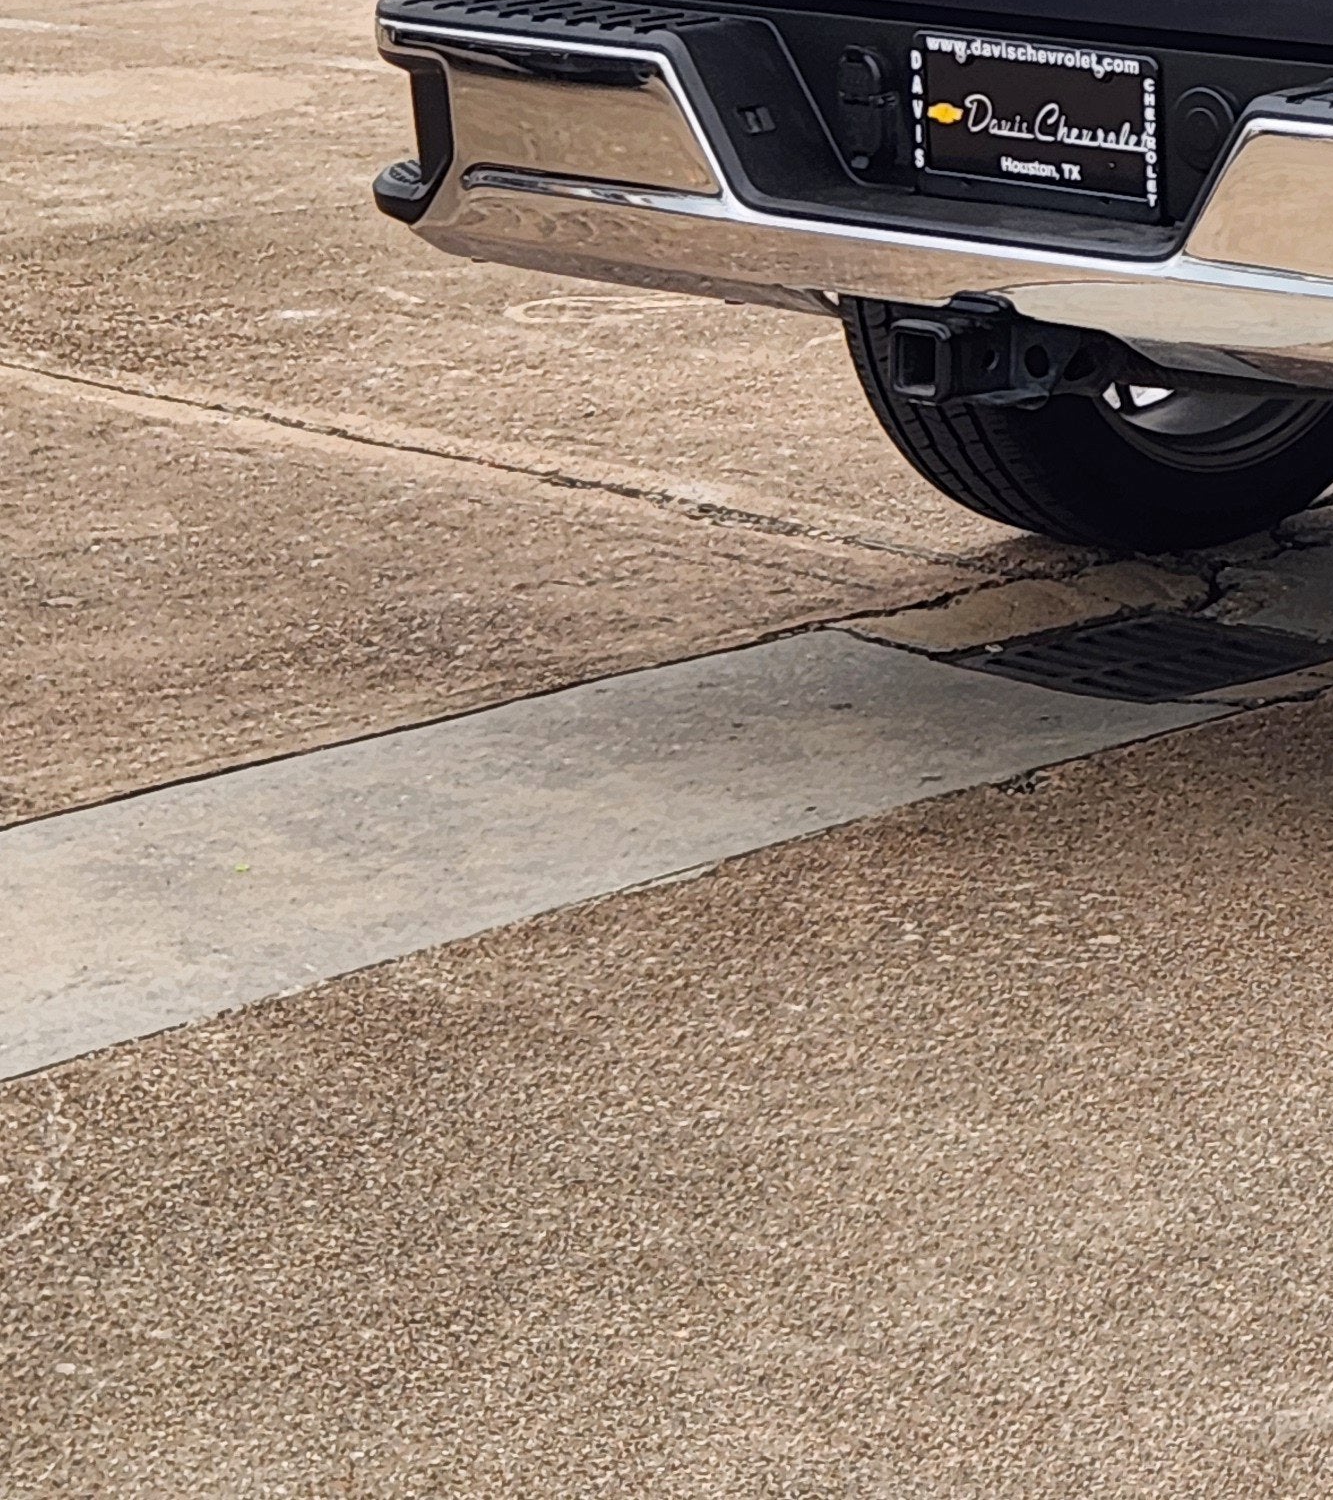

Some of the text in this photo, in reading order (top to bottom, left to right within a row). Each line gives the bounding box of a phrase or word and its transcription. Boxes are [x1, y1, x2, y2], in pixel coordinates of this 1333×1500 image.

[926, 36, 1140, 77] www.davischevrolet.com
[910, 50, 925, 169] DAVIS
[964, 94, 1149, 152] Davis Chevrolet
[1000, 156, 1082, 181] Houston, TX
[1143, 78, 1157, 208] CHEVROLET
